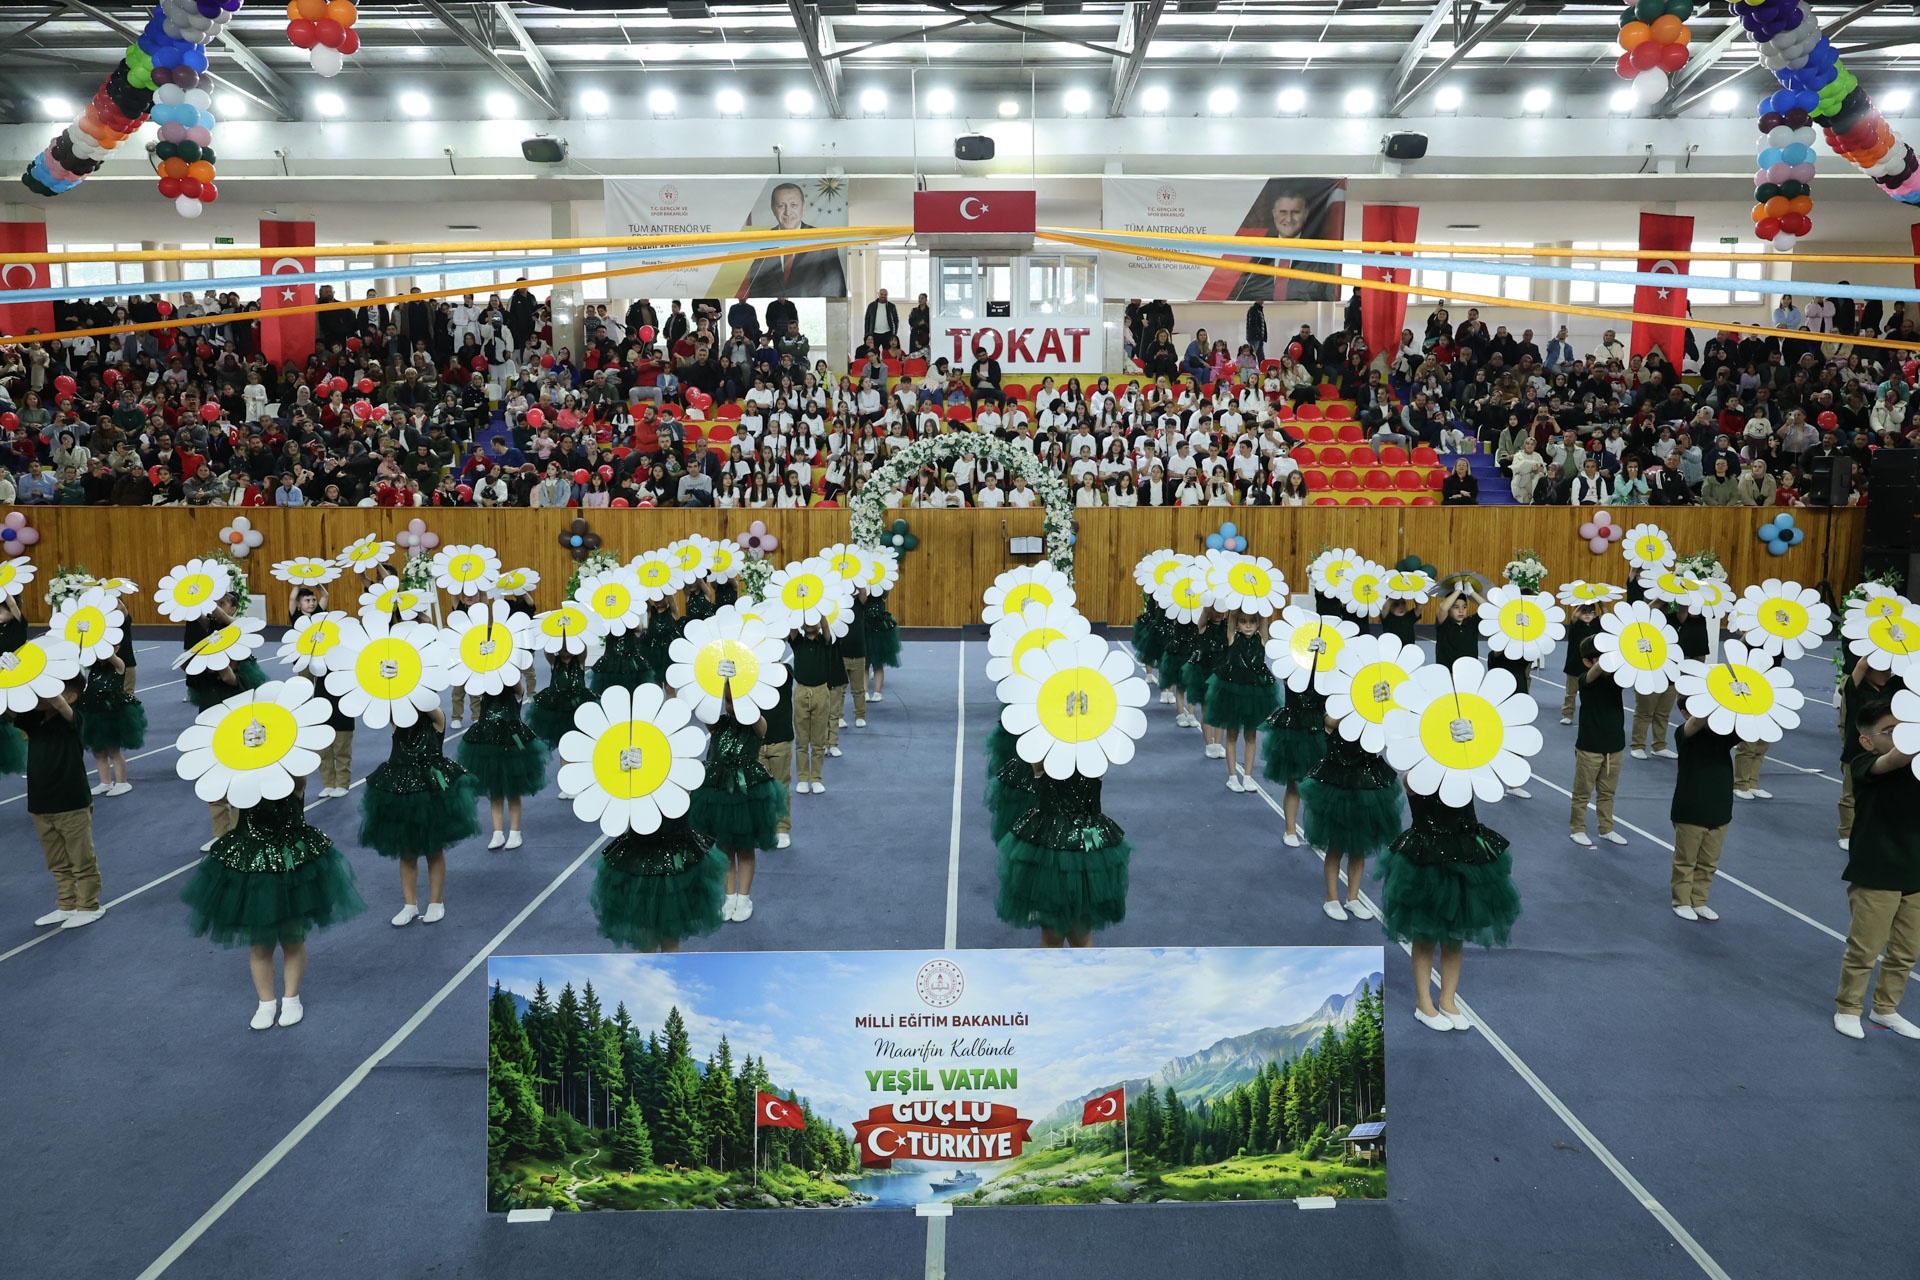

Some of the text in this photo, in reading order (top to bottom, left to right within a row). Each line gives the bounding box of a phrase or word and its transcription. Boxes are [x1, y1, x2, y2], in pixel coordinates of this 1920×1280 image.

[628, 223, 712, 233] TÜM ANTRENÖR VE
[1124, 223, 1207, 235] TÜM ANTRENÖR VE
[1128, 262, 1154, 270] GENÇLİK
[945, 327, 1090, 363] TOKAT
[855, 1011, 1029, 1028] MİLLİ EĞİTİM BAKANLIĞI
[874, 1037, 1016, 1063] Maarifin Kalbinde
[865, 1067, 1018, 1095] YEŞİL VATAN
[906, 1126, 1012, 1158] TÜRKİYE
